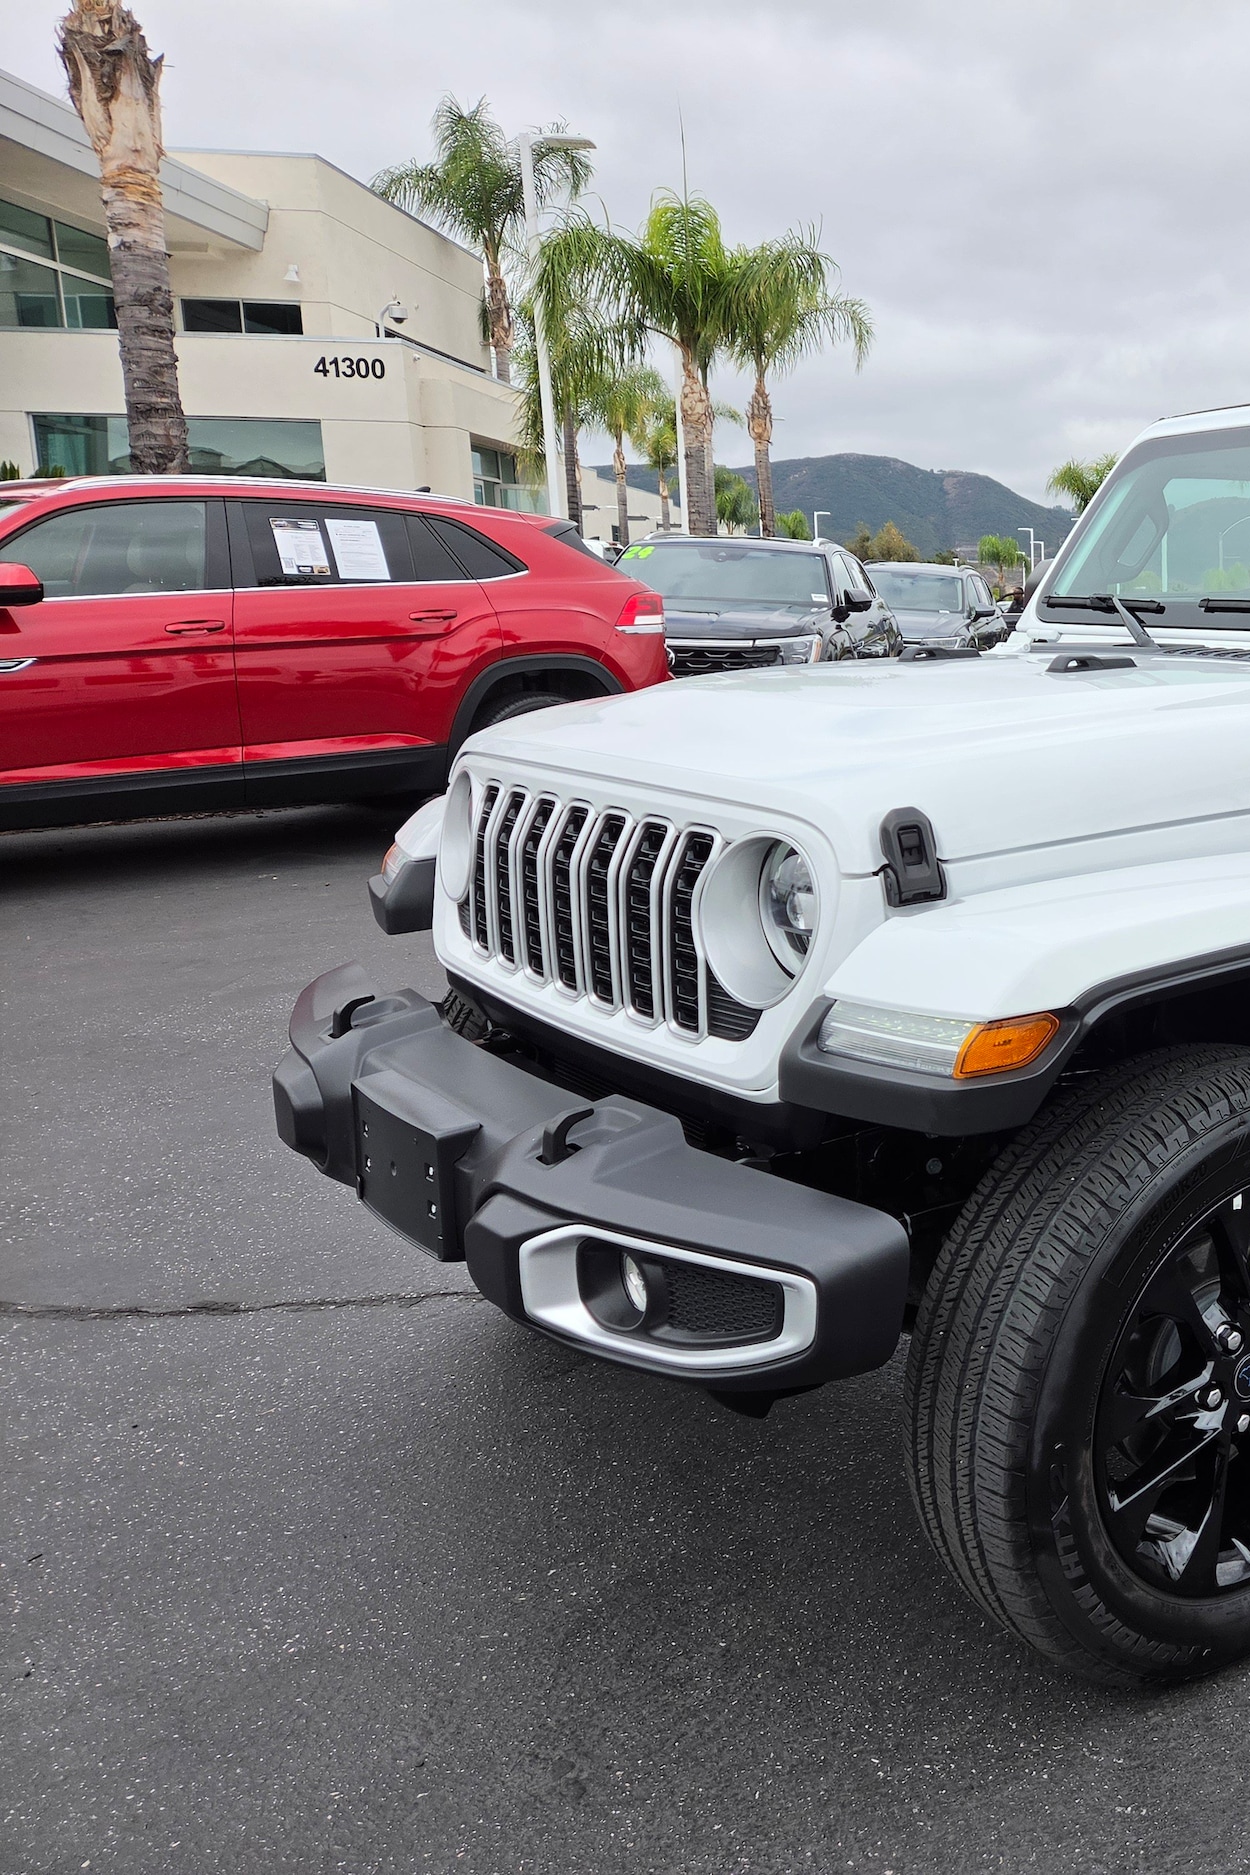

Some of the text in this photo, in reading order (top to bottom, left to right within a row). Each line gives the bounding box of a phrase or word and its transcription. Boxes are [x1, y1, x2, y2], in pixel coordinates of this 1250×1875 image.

[314, 356, 385, 379] 41300
[621, 545, 655, 559] 24
[1136, 1163, 1208, 1247] 255/60R20
[1072, 1582, 1202, 1665] ROADIAN
